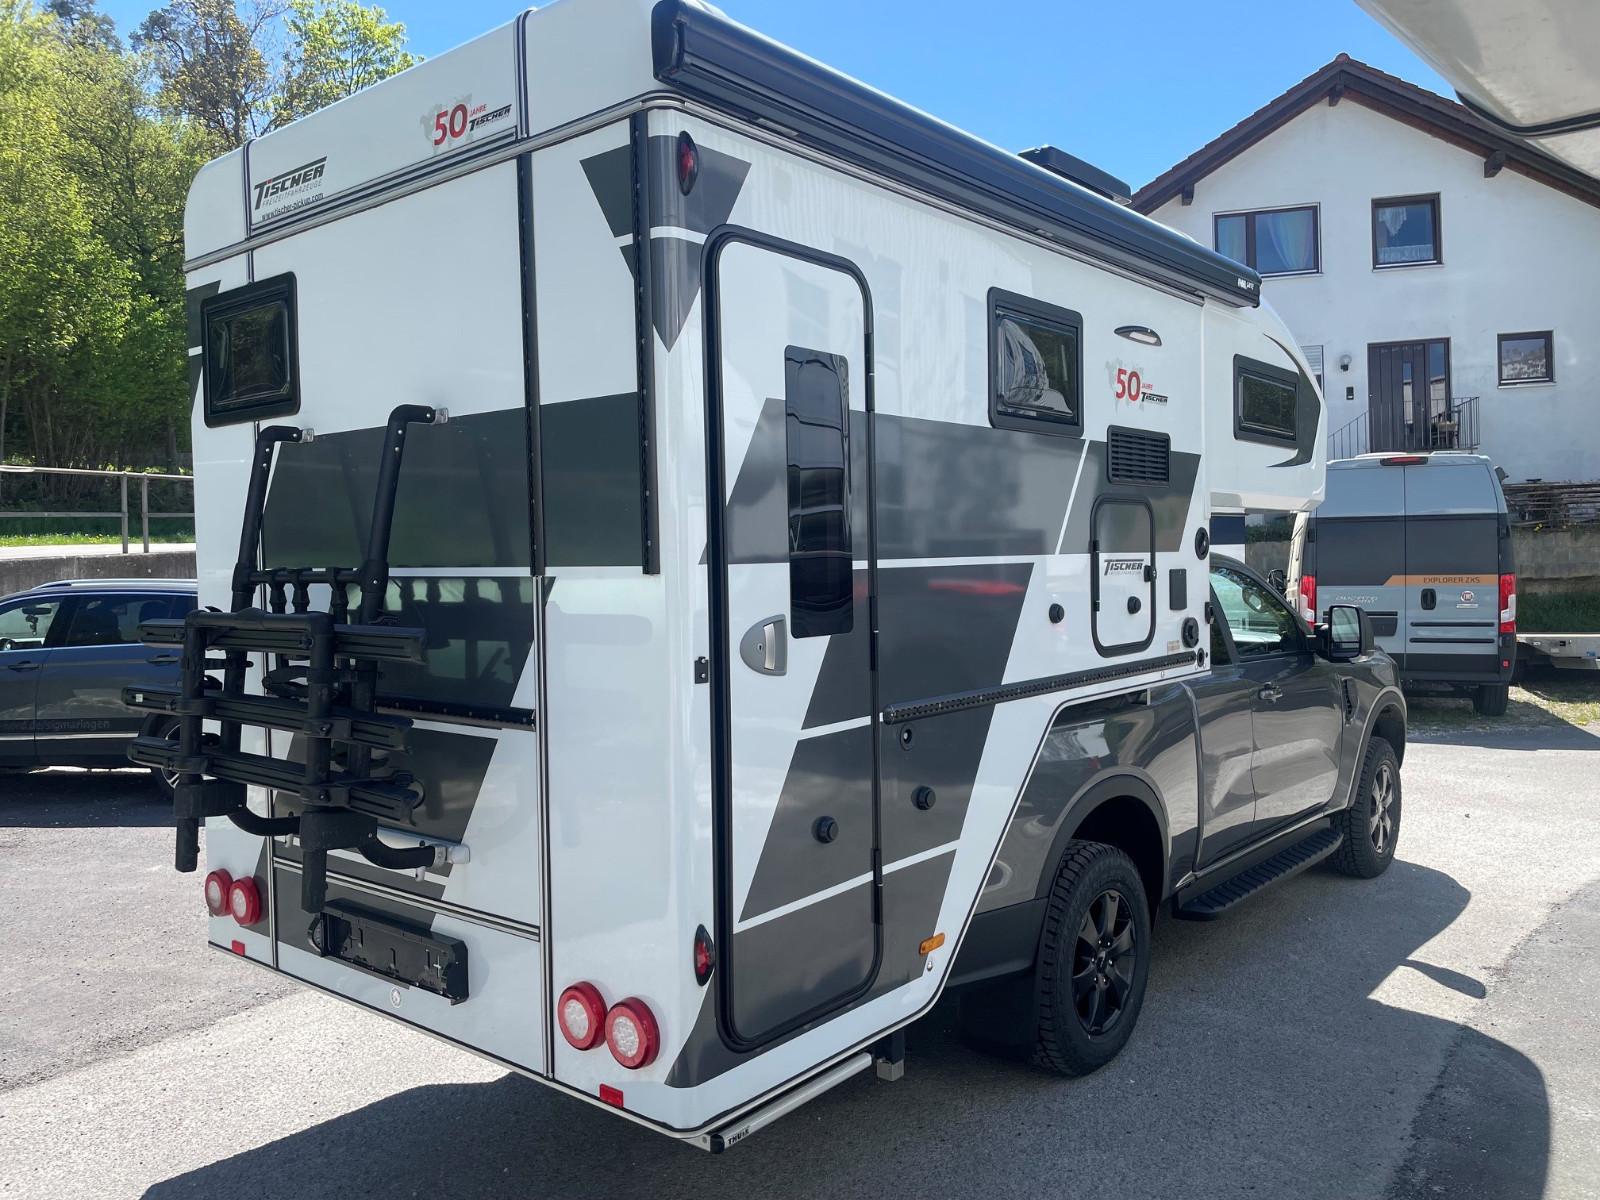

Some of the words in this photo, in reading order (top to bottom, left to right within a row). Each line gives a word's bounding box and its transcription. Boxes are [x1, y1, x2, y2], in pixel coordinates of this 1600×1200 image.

[433, 103, 468, 146] 50
[1115, 367, 1141, 402] 50
[1424, 576, 1464, 584] EXPLORER
